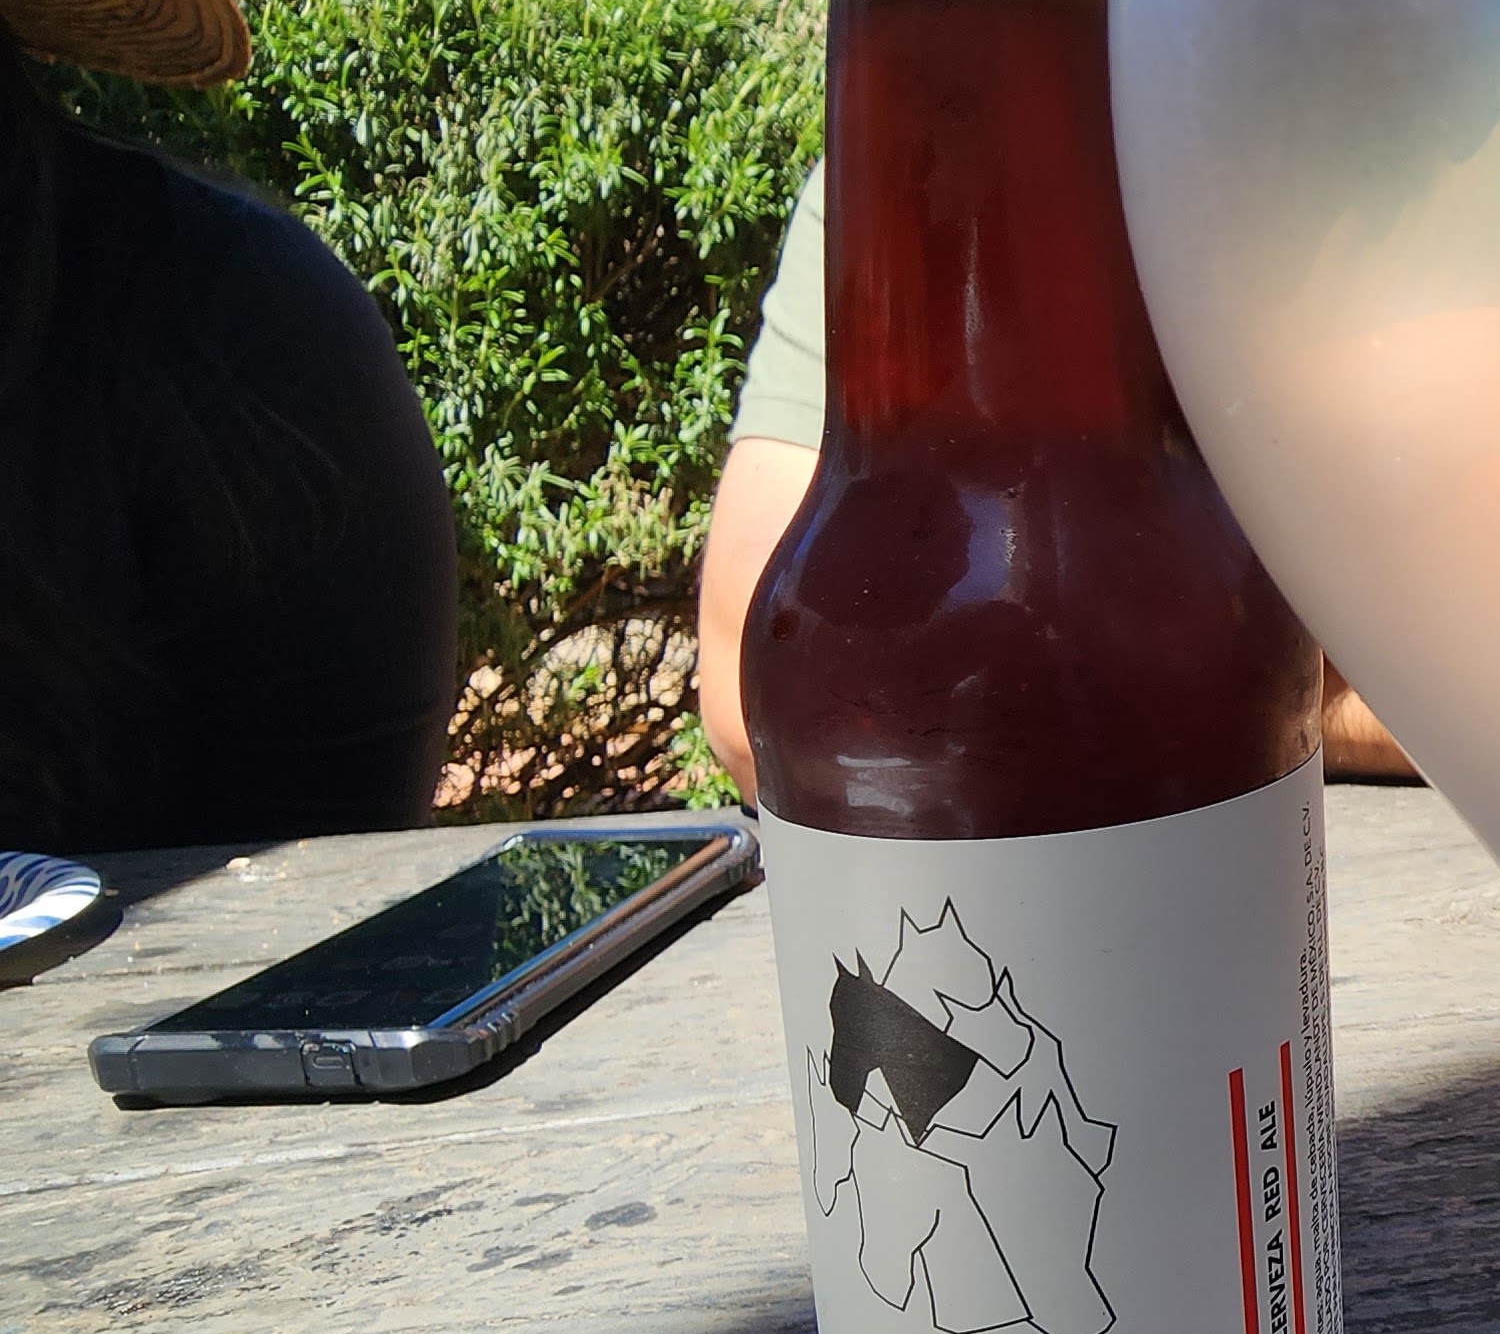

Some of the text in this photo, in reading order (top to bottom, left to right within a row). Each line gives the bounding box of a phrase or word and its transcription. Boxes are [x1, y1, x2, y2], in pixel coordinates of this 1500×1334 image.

[1298, 948, 1310, 1033] levadura.
[1302, 1048, 1314, 1108] lúpulo
[1259, 1100, 1277, 1150] ALE
[1305, 1106, 1317, 1174] cebada,
[1264, 1166, 1282, 1223] RED
[1309, 1176, 1318, 1200] de
[1311, 1202, 1320, 1251] malta
[1314, 1251, 1323, 1300] agua,
